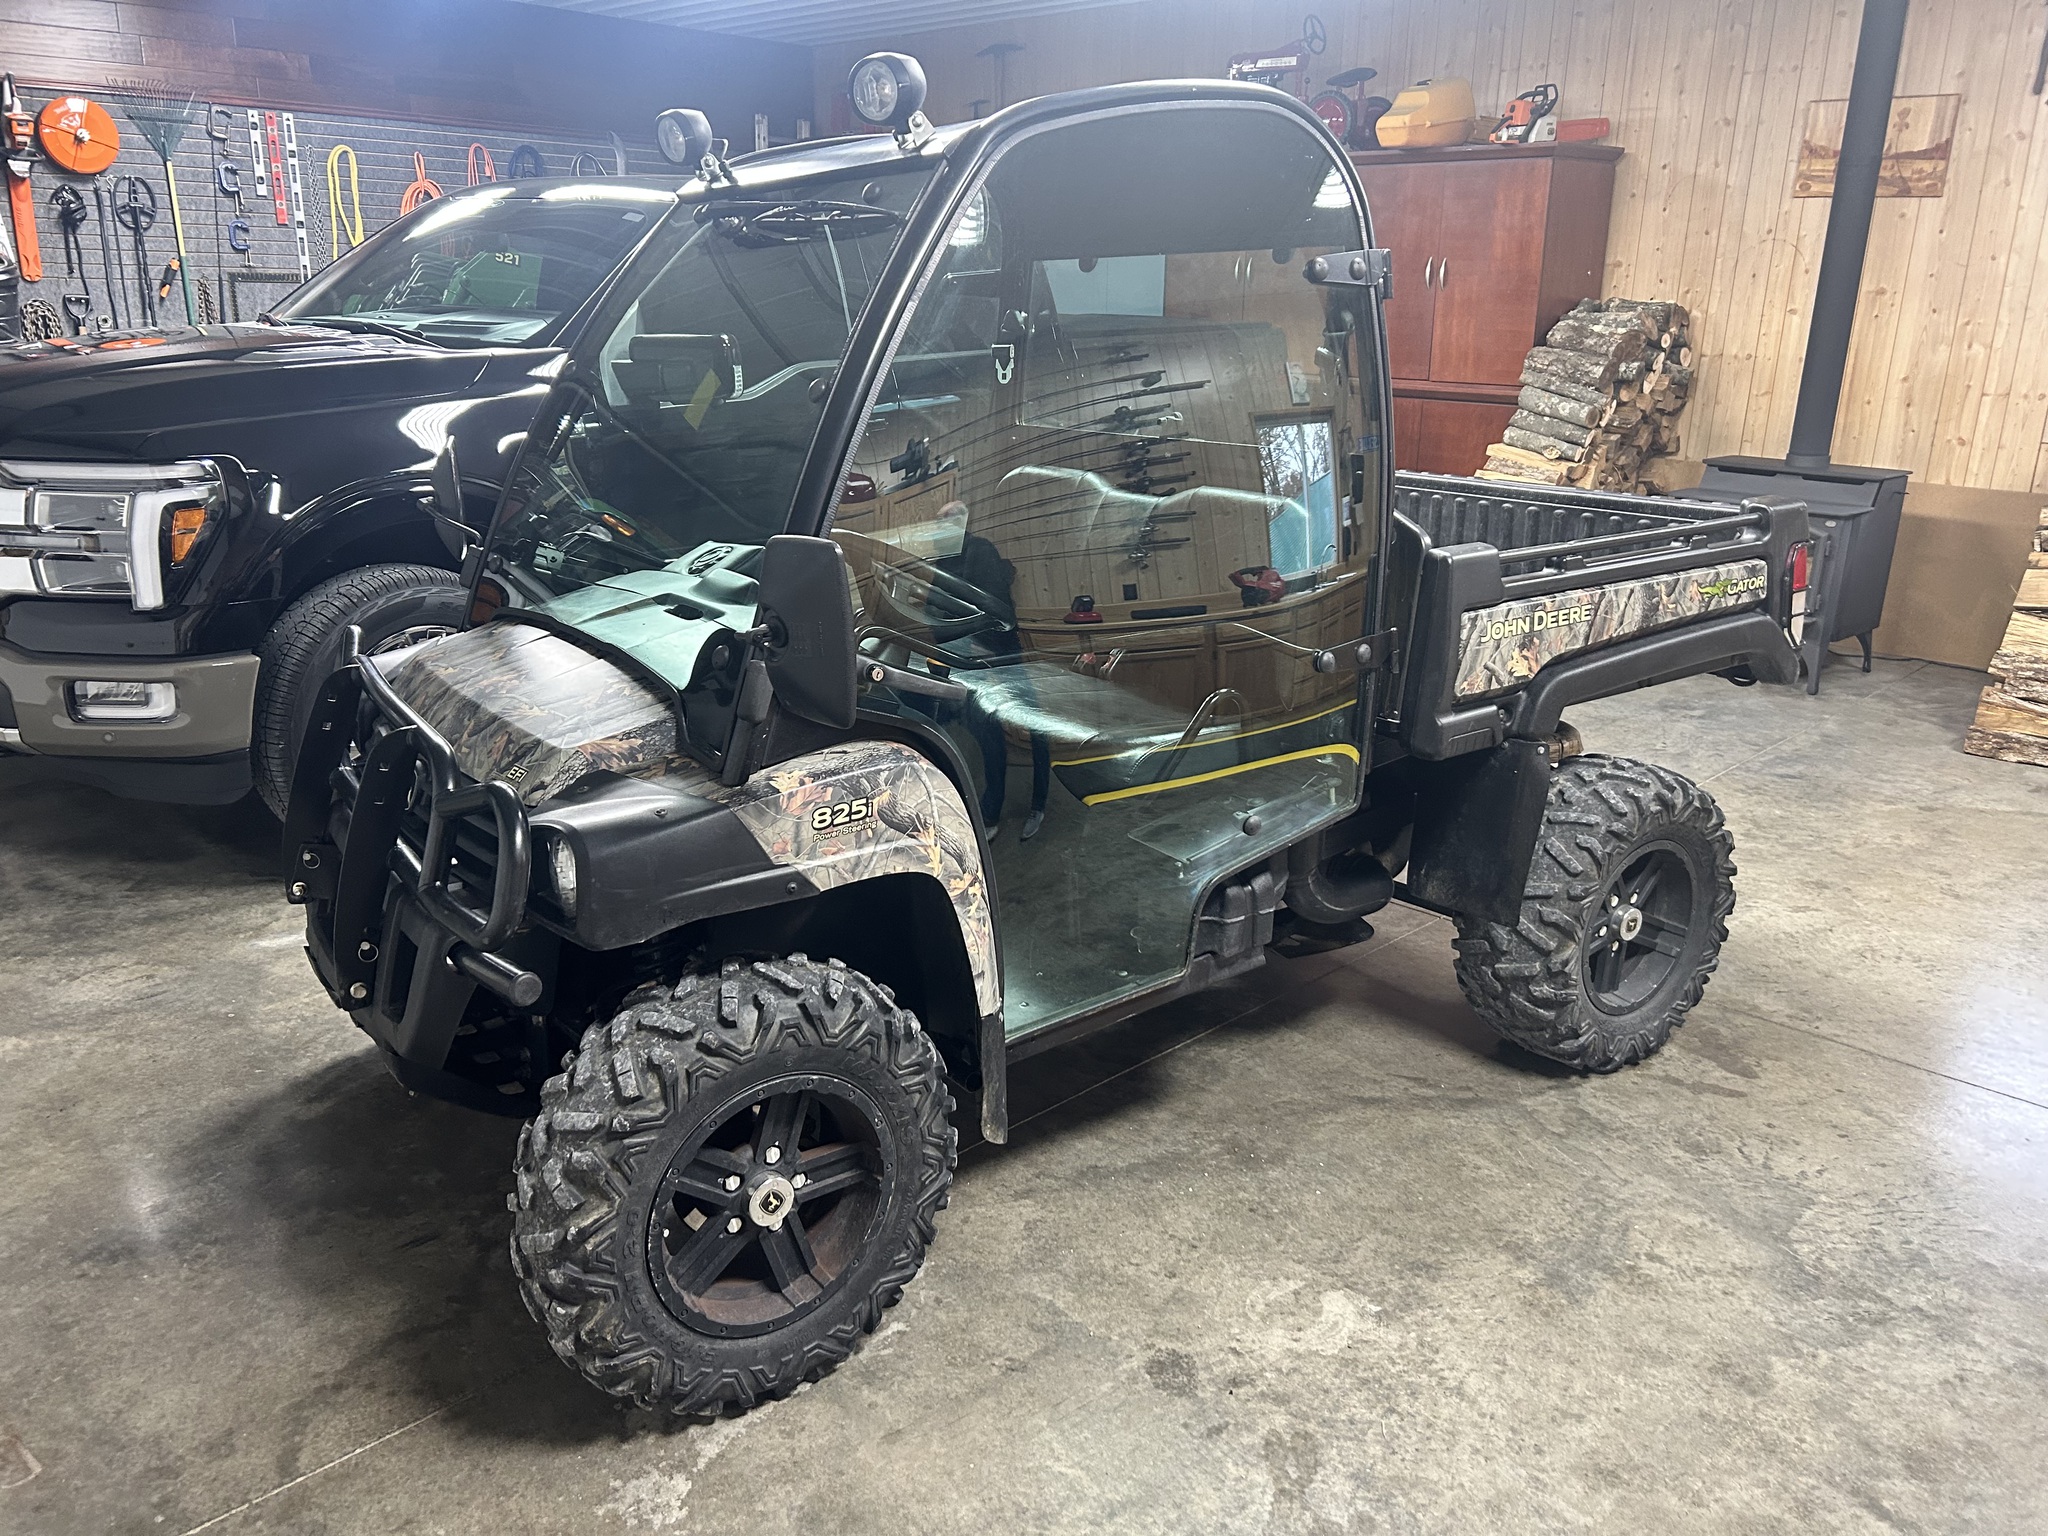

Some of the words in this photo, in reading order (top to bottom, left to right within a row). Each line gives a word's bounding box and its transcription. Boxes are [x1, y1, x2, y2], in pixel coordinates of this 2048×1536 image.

[495, 252, 520, 266] 521
[1727, 576, 1765, 595] GATOR
[1480, 619, 1530, 643] JOHN
[1533, 604, 1592, 632] DEERE
[507, 766, 528, 782] EFI
[812, 798, 873, 830] 825i
[813, 829, 840, 842] Power
[842, 820, 877, 835] Steering
